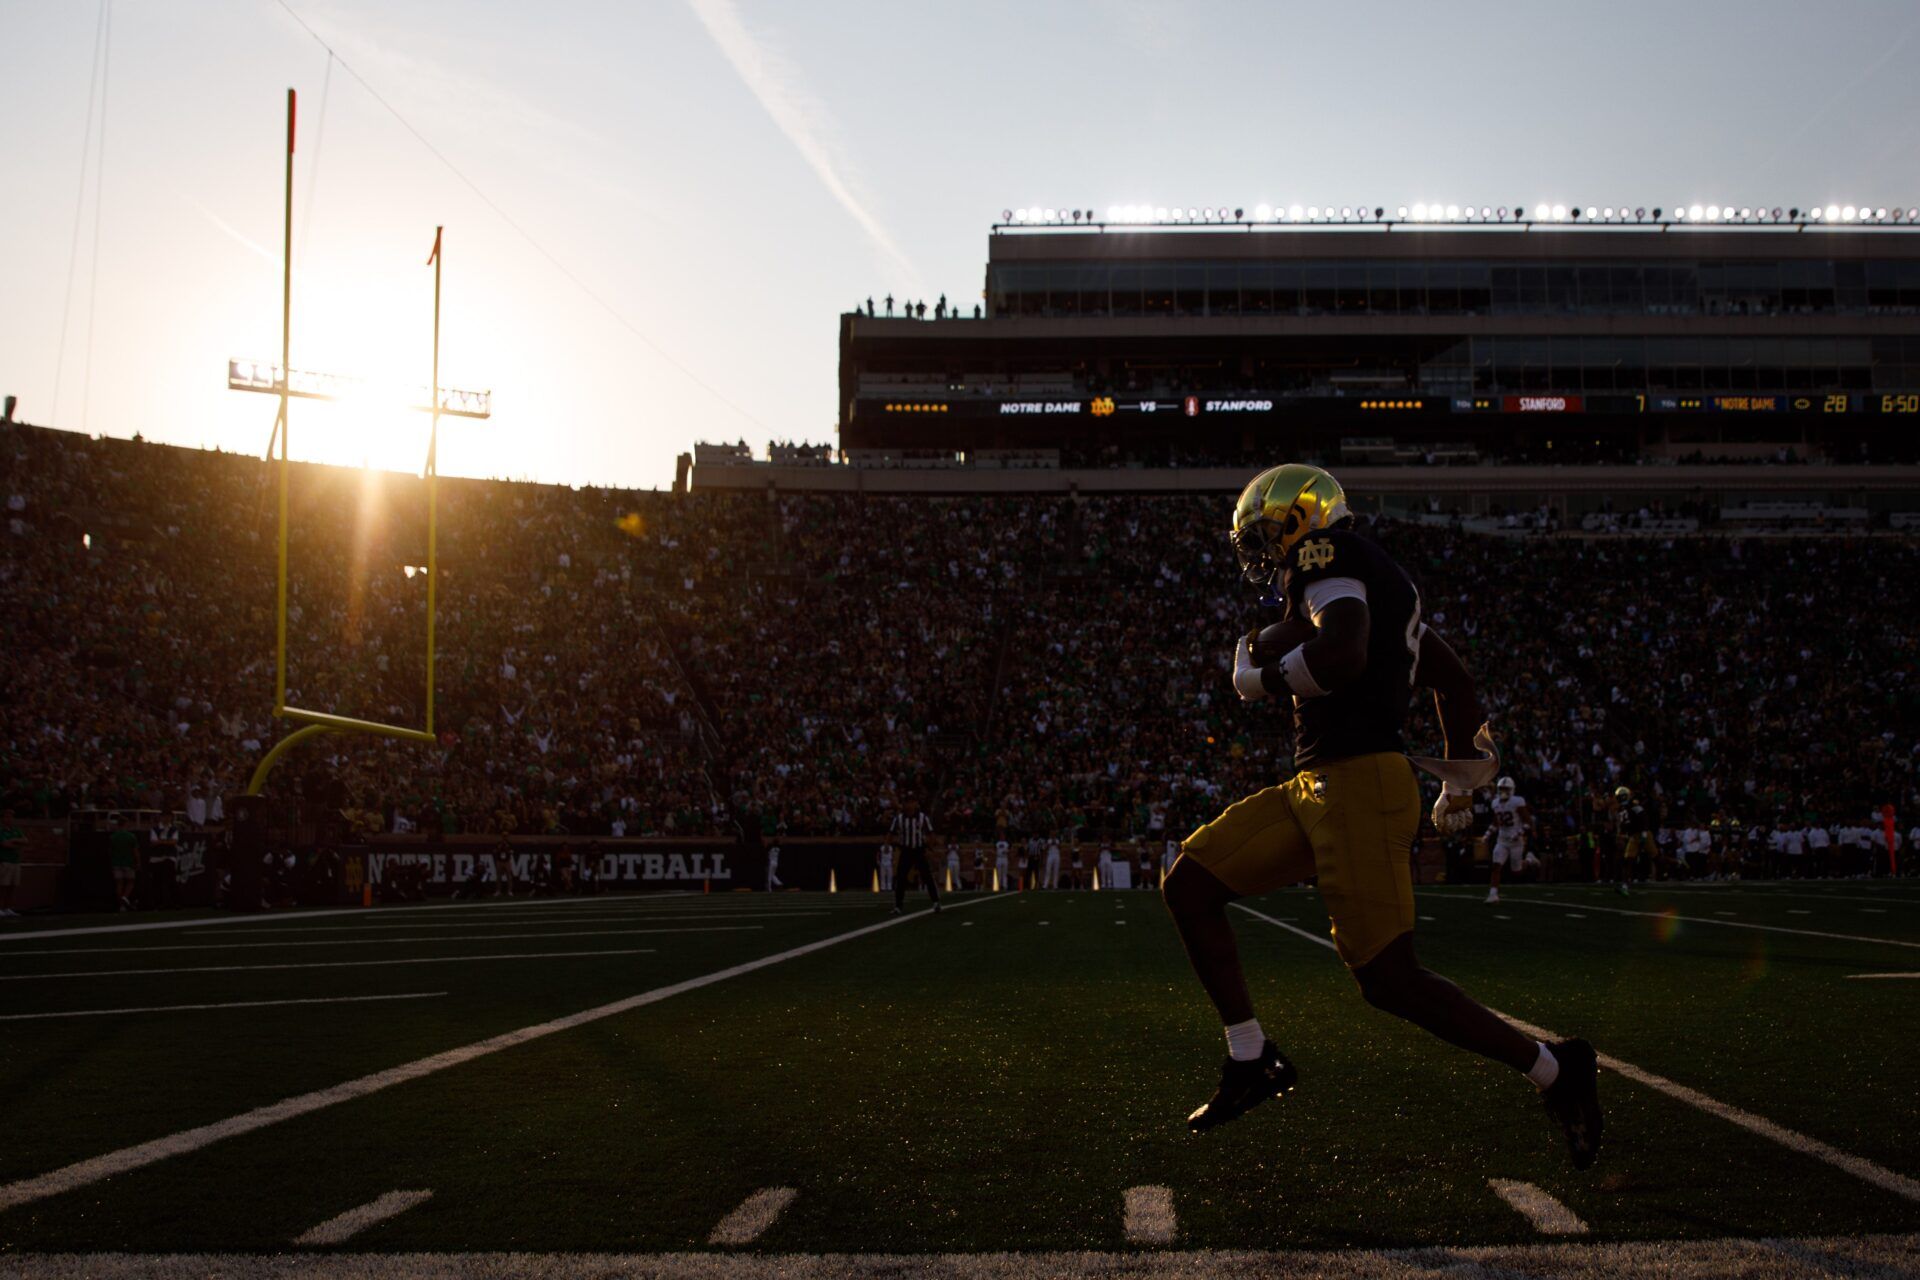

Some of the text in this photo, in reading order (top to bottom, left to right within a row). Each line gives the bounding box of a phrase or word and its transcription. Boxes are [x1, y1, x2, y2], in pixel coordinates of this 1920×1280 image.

[1000, 401, 1081, 414] NOTRE DAME
[1140, 400, 1157, 412] VS
[1205, 400, 1274, 412] STANFORD
[1519, 397, 1566, 412] STANFORD
[1635, 394, 1646, 414] 7
[1720, 396, 1749, 411] NOTRE
[1751, 396, 1777, 411] DAME
[1823, 394, 1848, 413] 28
